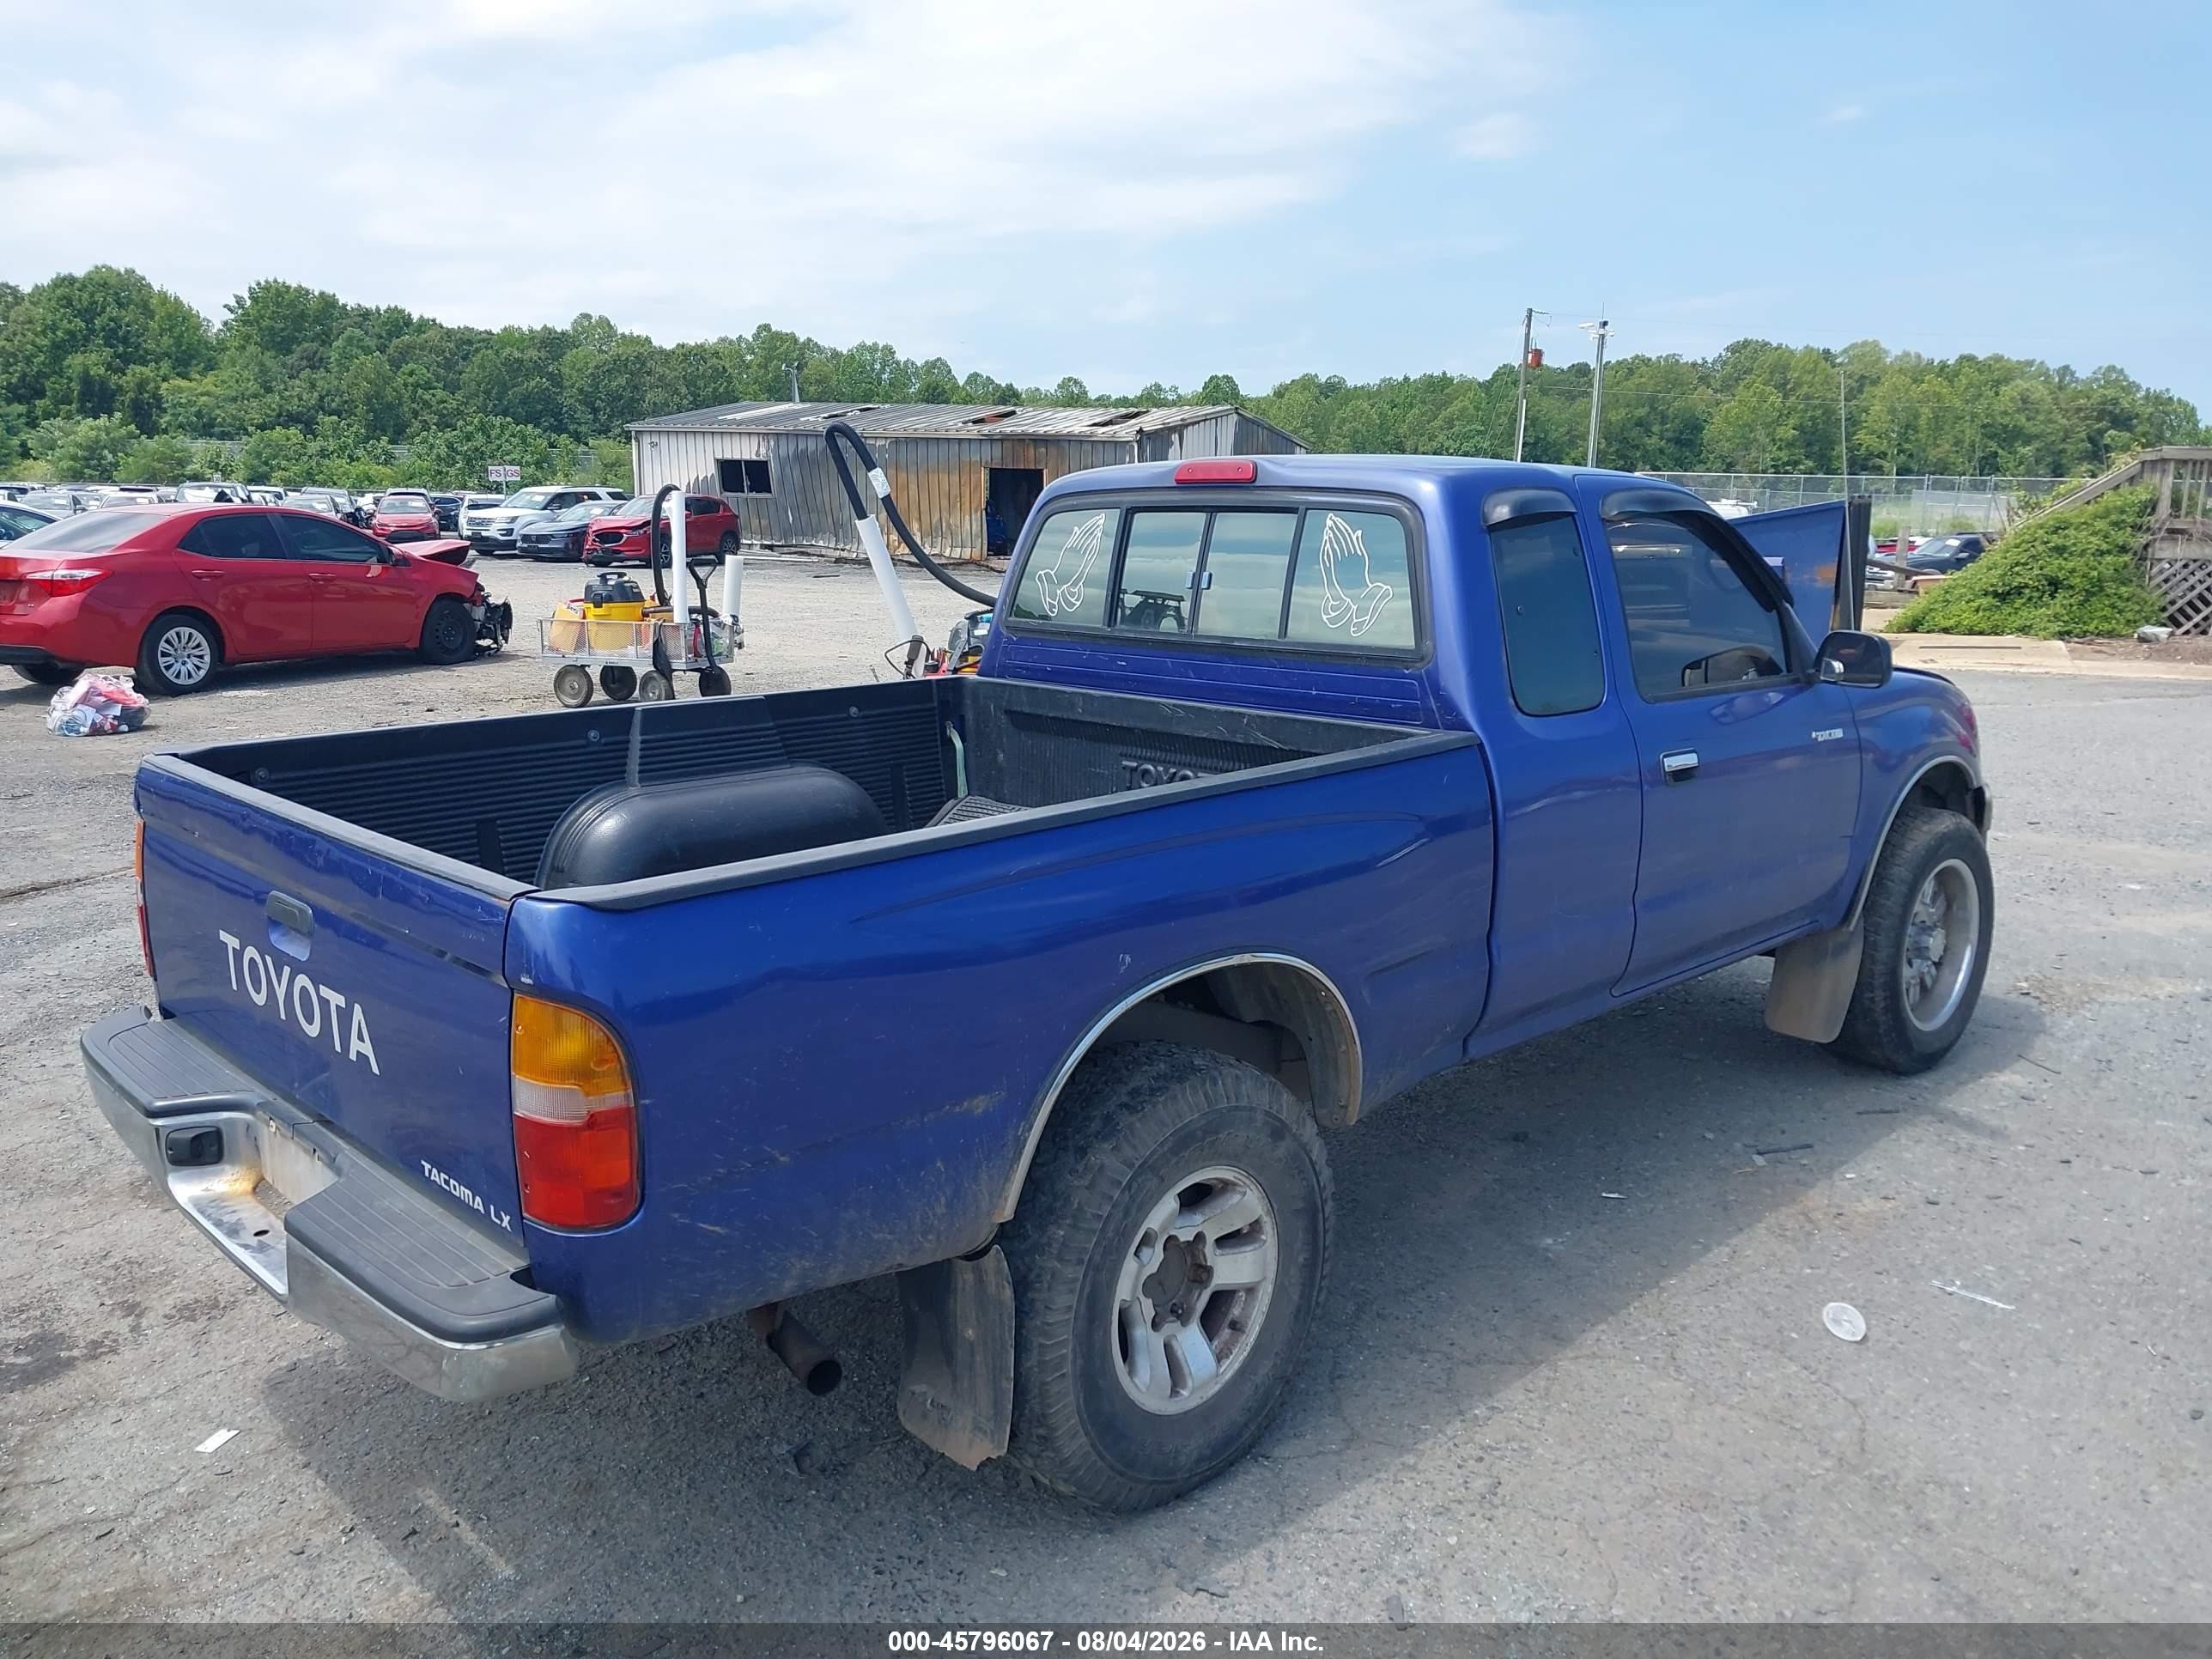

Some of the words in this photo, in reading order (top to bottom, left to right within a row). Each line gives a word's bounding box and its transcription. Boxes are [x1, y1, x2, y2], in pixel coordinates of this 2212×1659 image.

[489, 469, 502, 477] FS
[507, 469, 520, 477] GS
[1121, 761, 1214, 787] TOYO
[219, 930, 380, 1076] TOYOTA
[421, 1159, 485, 1214] TACOMA
[489, 1204, 512, 1232] LX
